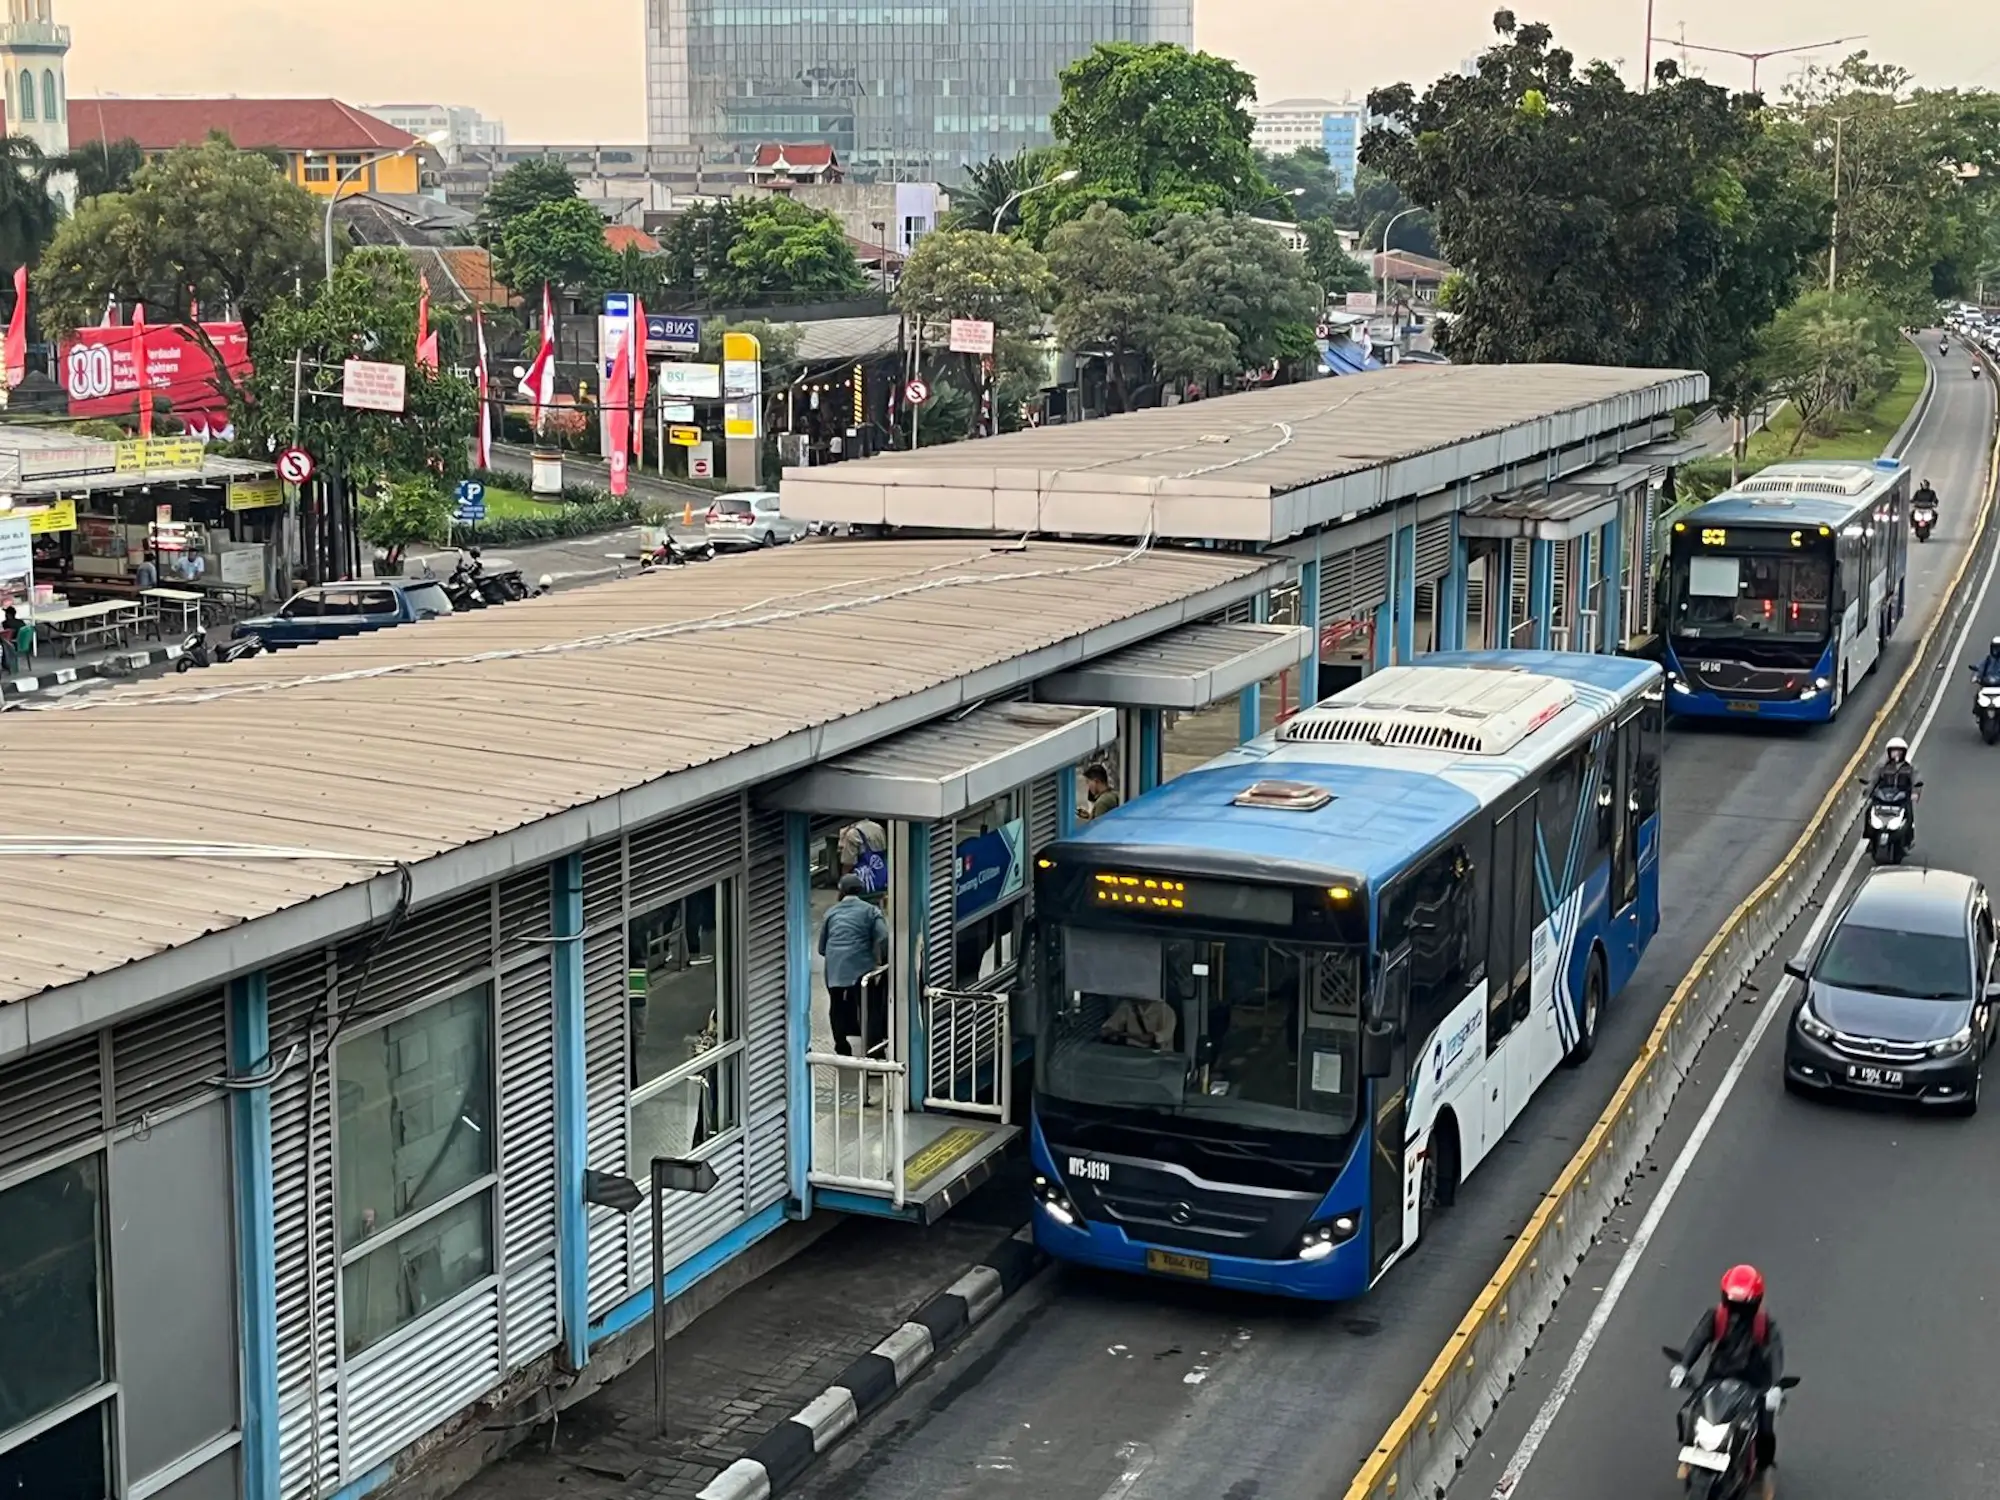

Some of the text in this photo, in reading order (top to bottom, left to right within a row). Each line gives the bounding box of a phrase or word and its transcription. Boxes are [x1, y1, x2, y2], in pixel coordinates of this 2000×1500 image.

[666, 321, 695, 335] BWS
[68, 343, 112, 400] 80
[466, 483, 481, 500] P
